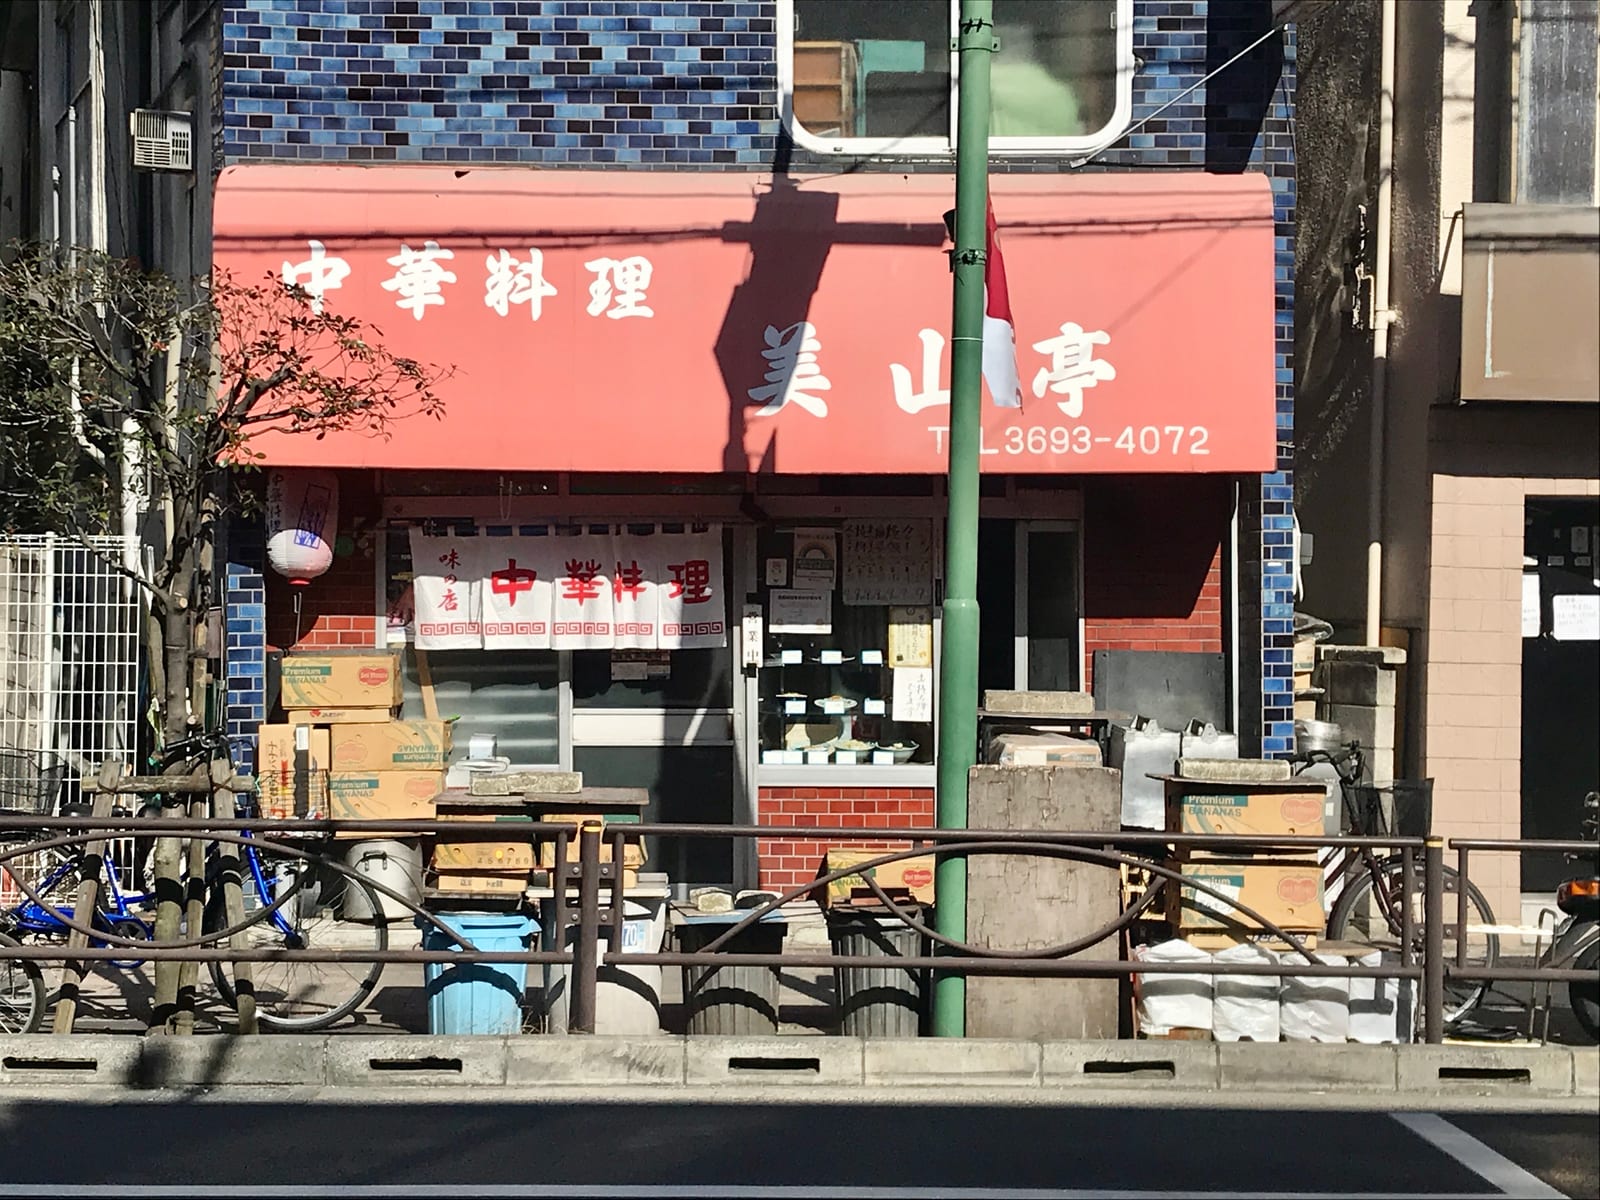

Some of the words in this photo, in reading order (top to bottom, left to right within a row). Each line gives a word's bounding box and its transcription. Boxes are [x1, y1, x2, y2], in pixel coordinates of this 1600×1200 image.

[281, 240, 655, 321] 中華料理
[747, 321, 1117, 419] 美山亭
[928, 426, 1210, 455] TL3693-4072
[437, 548, 462, 612] 味の店
[490, 558, 712, 607] 中華料理
[1188, 795, 1234, 805] Premium
[1188, 806, 1242, 818] BANANAS
